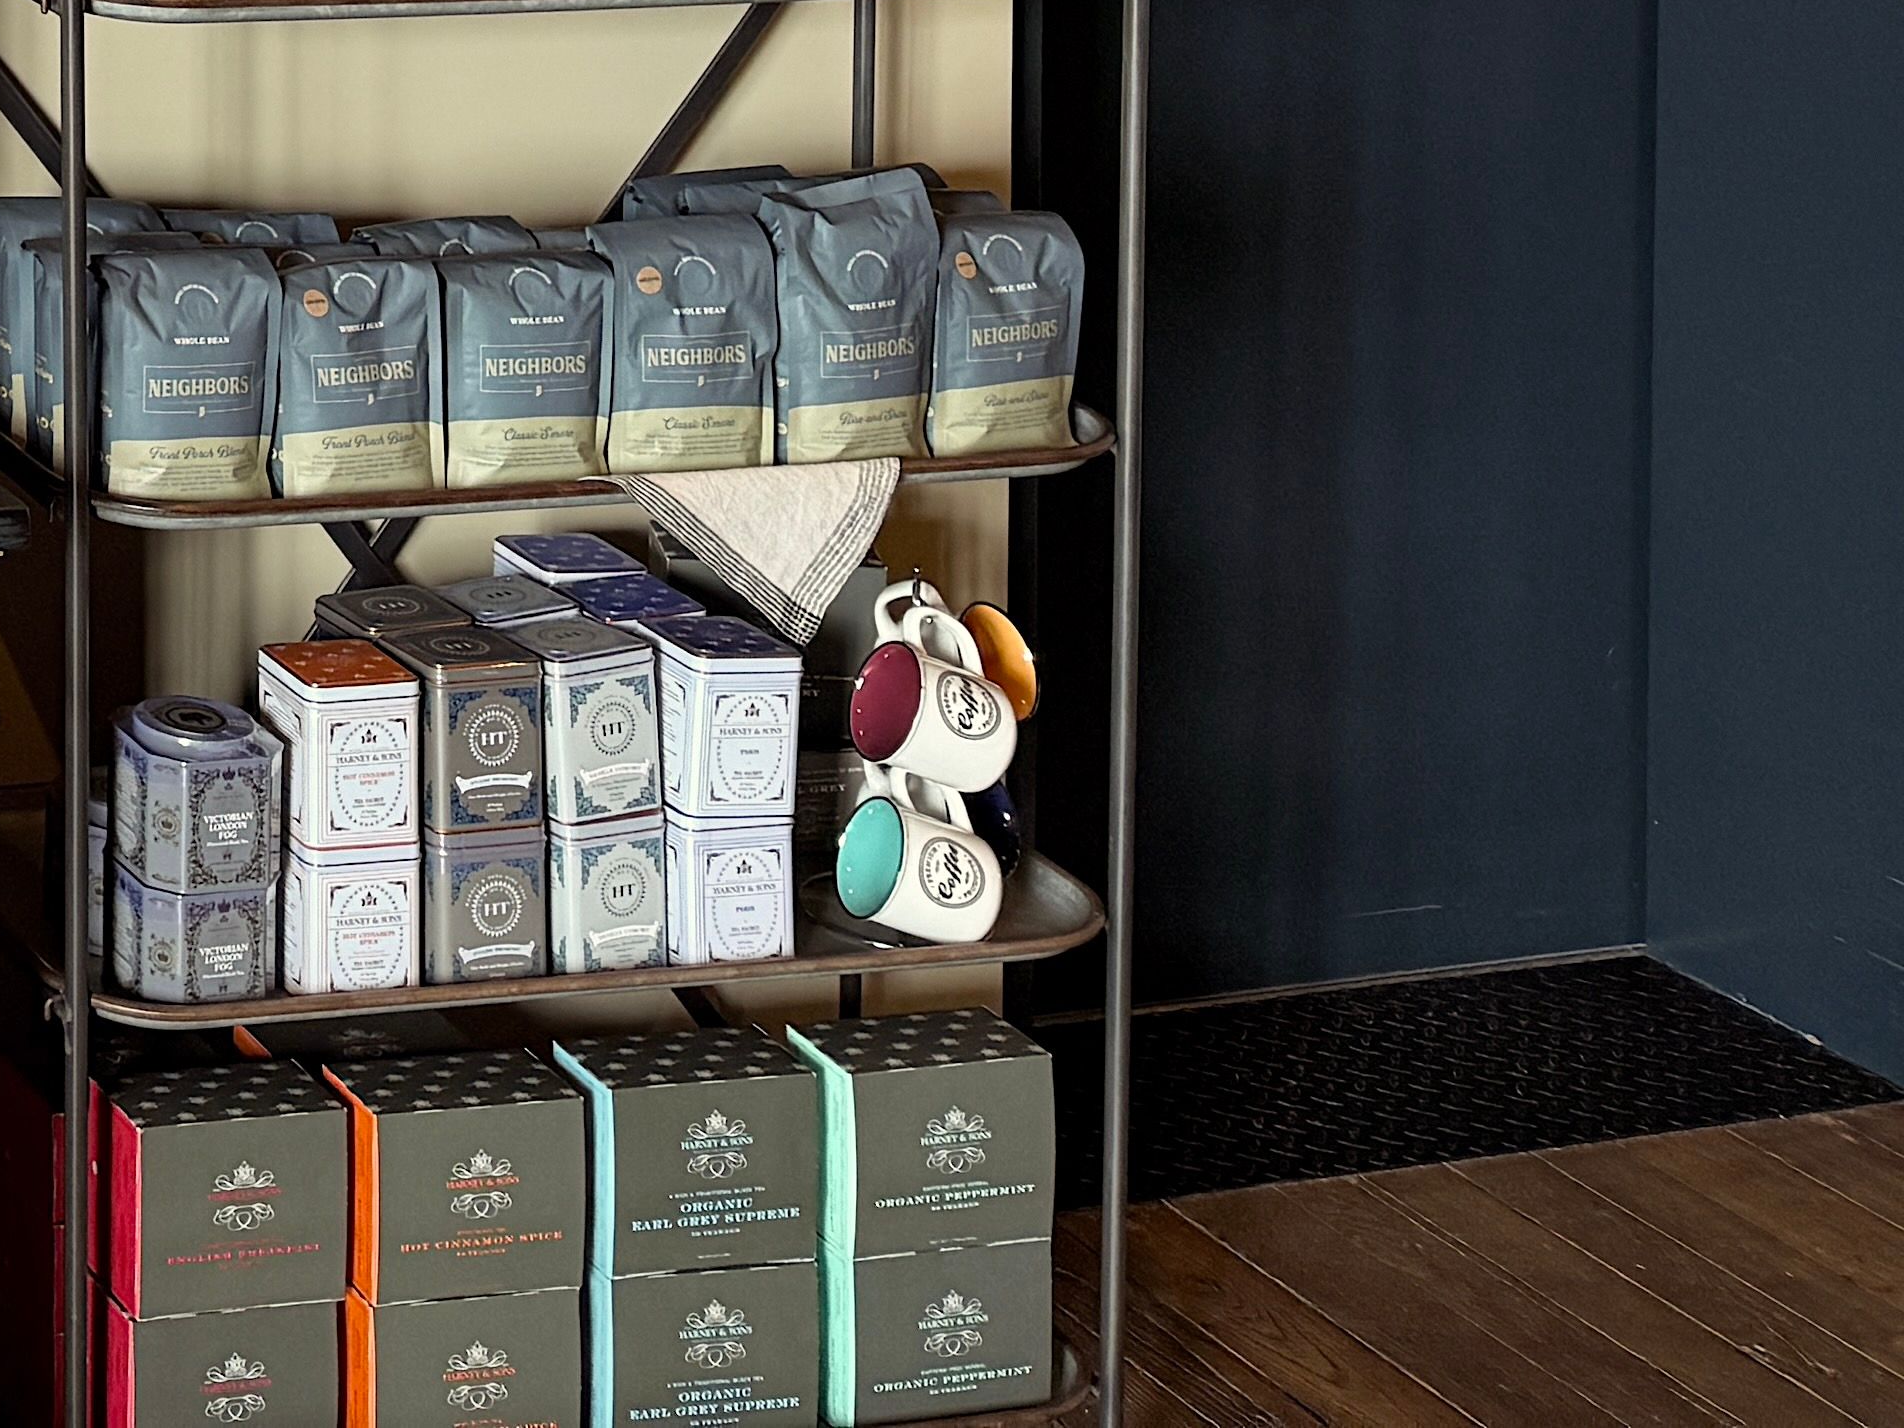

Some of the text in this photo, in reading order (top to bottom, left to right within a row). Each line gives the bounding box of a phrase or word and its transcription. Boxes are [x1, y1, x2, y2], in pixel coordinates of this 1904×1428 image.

[971, 319, 1059, 348] NEIGHBORS
[647, 344, 746, 368] NEIGHBORS
[826, 336, 915, 363] NEIGHBORS
[316, 360, 414, 388] NEIGHBORS
[485, 355, 586, 377] NEIGHBORS
[148, 375, 248, 399] NEIGHBORS
[322, 434, 352, 451] Front
[354, 433, 386, 448] Porch
[203, 811, 253, 825] VICTORIAN
[208, 821, 247, 832] LONDON
[218, 830, 238, 840] FOG
[199, 943, 249, 956] VICTORIAN
[204, 952, 243, 964] LONDON
[214, 962, 233, 972] FOG
[680, 1198, 753, 1213] ORGANIC
[875, 1195, 940, 1210] ORGANIC
[945, 1184, 1035, 1203] PEPPERMINT
[632, 1207, 800, 1232] EARL GREY SUPREME
[400, 1230, 564, 1254] HOT CINNAMON SPICE
[873, 1366, 1033, 1394] ORGANIC PEPPERMINT
[678, 1386, 751, 1402] ORGANIC
[629, 1397, 800, 1421] EARL GREY SUPREME
